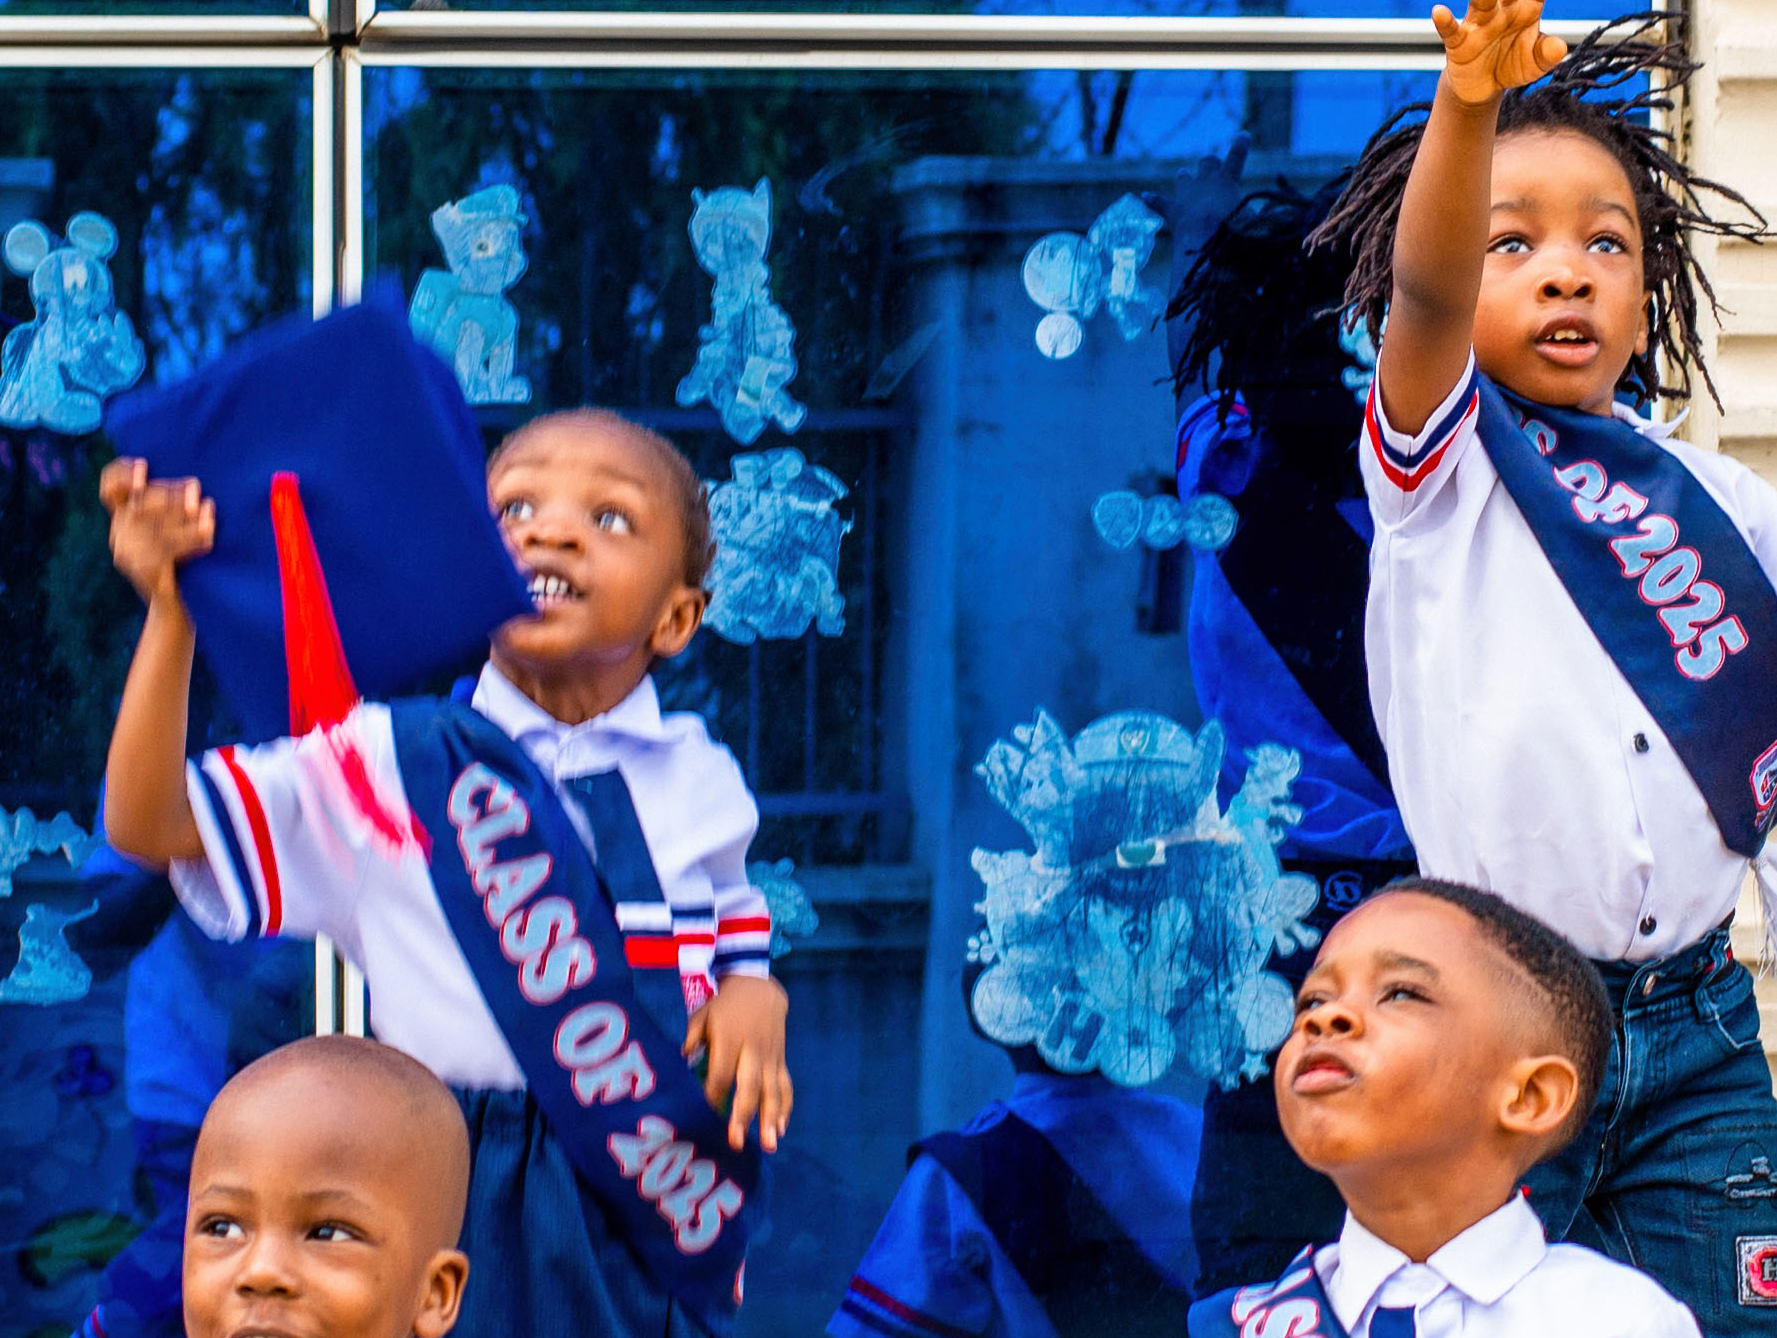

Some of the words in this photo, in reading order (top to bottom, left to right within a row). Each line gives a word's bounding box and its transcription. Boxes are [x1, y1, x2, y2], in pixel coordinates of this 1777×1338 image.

[1609, 514, 1749, 681] 2025
[448, 762, 597, 1006] CLASS
[553, 1001, 656, 1107] OF
[608, 1114, 743, 1255] 2025
